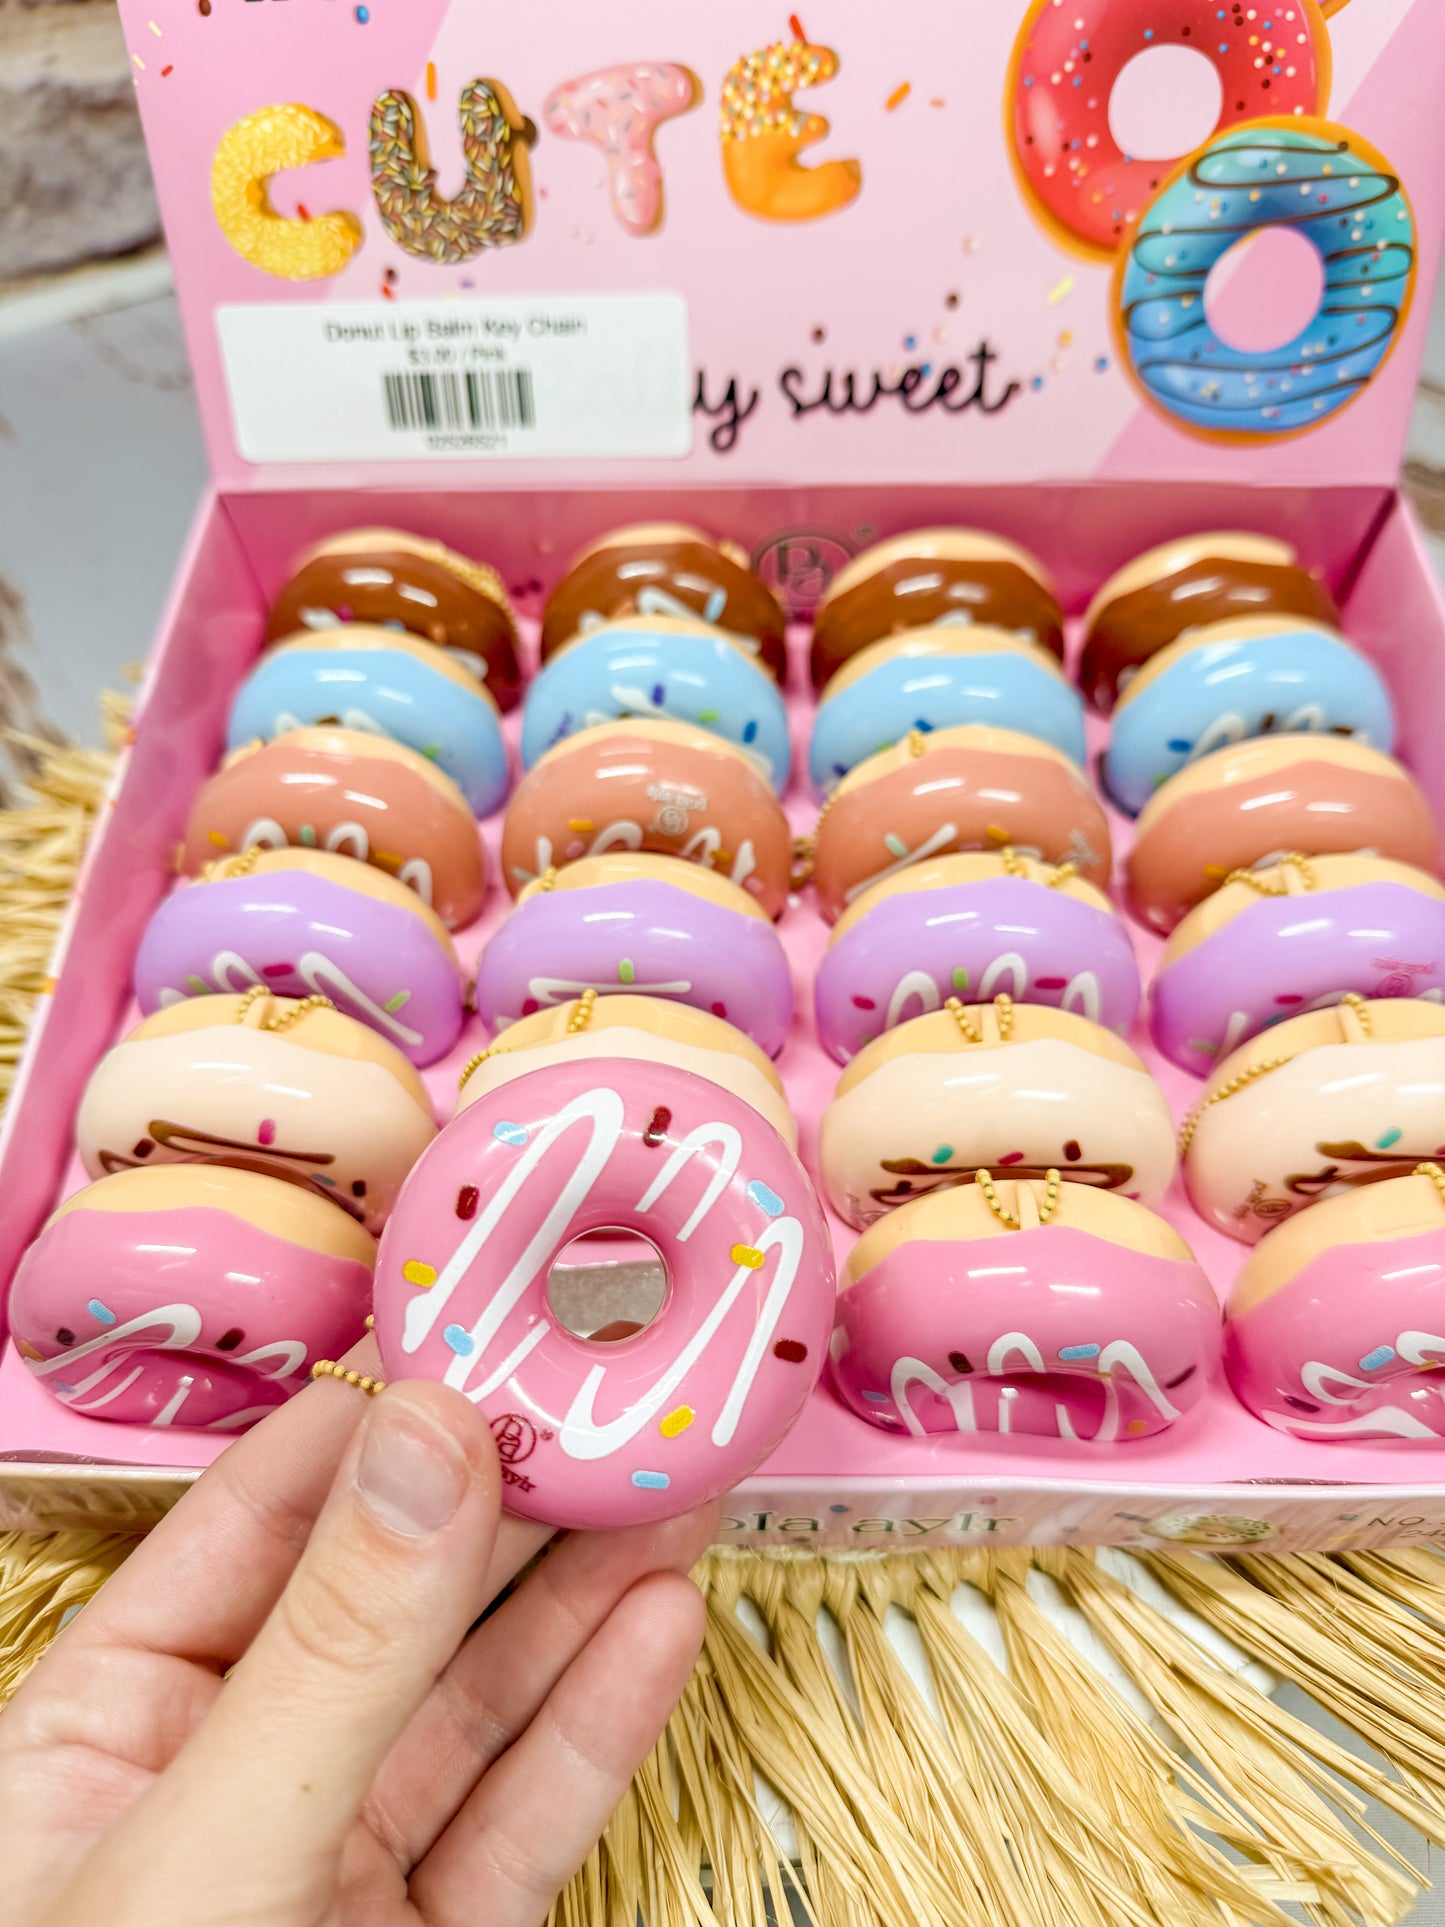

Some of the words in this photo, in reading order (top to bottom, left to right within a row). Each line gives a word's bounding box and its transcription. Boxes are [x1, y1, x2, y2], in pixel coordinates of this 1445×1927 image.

[211, 41, 862, 282] CUTE
[325, 320, 386, 343] Donut
[388, 319, 420, 346] Lip
[424, 317, 475, 340] Balm
[483, 316, 522, 343] Key
[528, 313, 587, 337] Chain
[779, 340, 1021, 418] sweet
